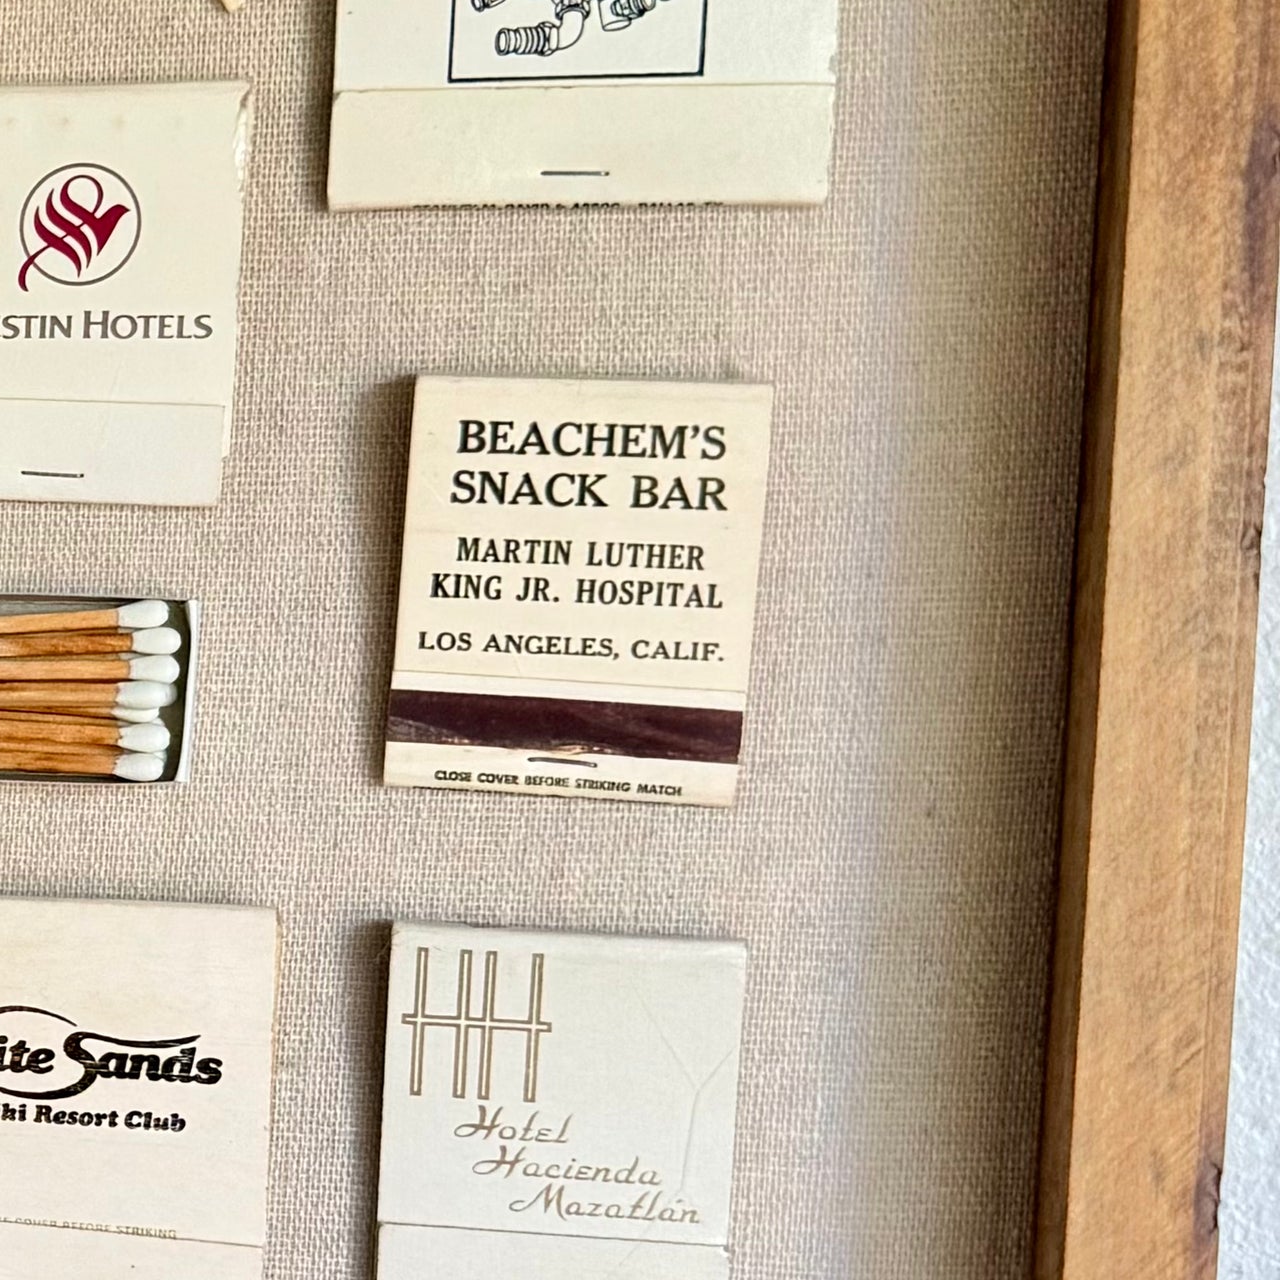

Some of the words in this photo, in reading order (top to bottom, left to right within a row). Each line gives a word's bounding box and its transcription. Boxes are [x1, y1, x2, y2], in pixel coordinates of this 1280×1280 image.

[83, 311, 213, 339] HOTELS
[457, 420, 726, 460] BEACHEM'S
[450, 470, 608, 507] SNACK
[630, 475, 728, 510] BAR
[457, 537, 572, 566] MARTIN
[587, 542, 705, 570] LUTHER
[430, 574, 502, 600] KING
[516, 578, 559, 603] JR.
[575, 579, 723, 608] HOSPITAL
[418, 632, 471, 651] LOS
[483, 635, 620, 660] ANGELES,
[632, 641, 724, 662] CALIF.
[435, 770, 472, 783] CLOSE
[478, 773, 519, 785] COVER
[525, 775, 569, 788] BEFORE
[575, 778, 631, 792] STRIKING
[637, 783, 682, 796] MATCH
[11, 1031, 223, 1100] Sands
[34, 1105, 118, 1127] Resort
[125, 1111, 186, 1132] Club
[454, 1105, 573, 1143] Hotel
[472, 1146, 662, 1186] Hacienda
[116, 1225, 177, 1239] STRIKING
